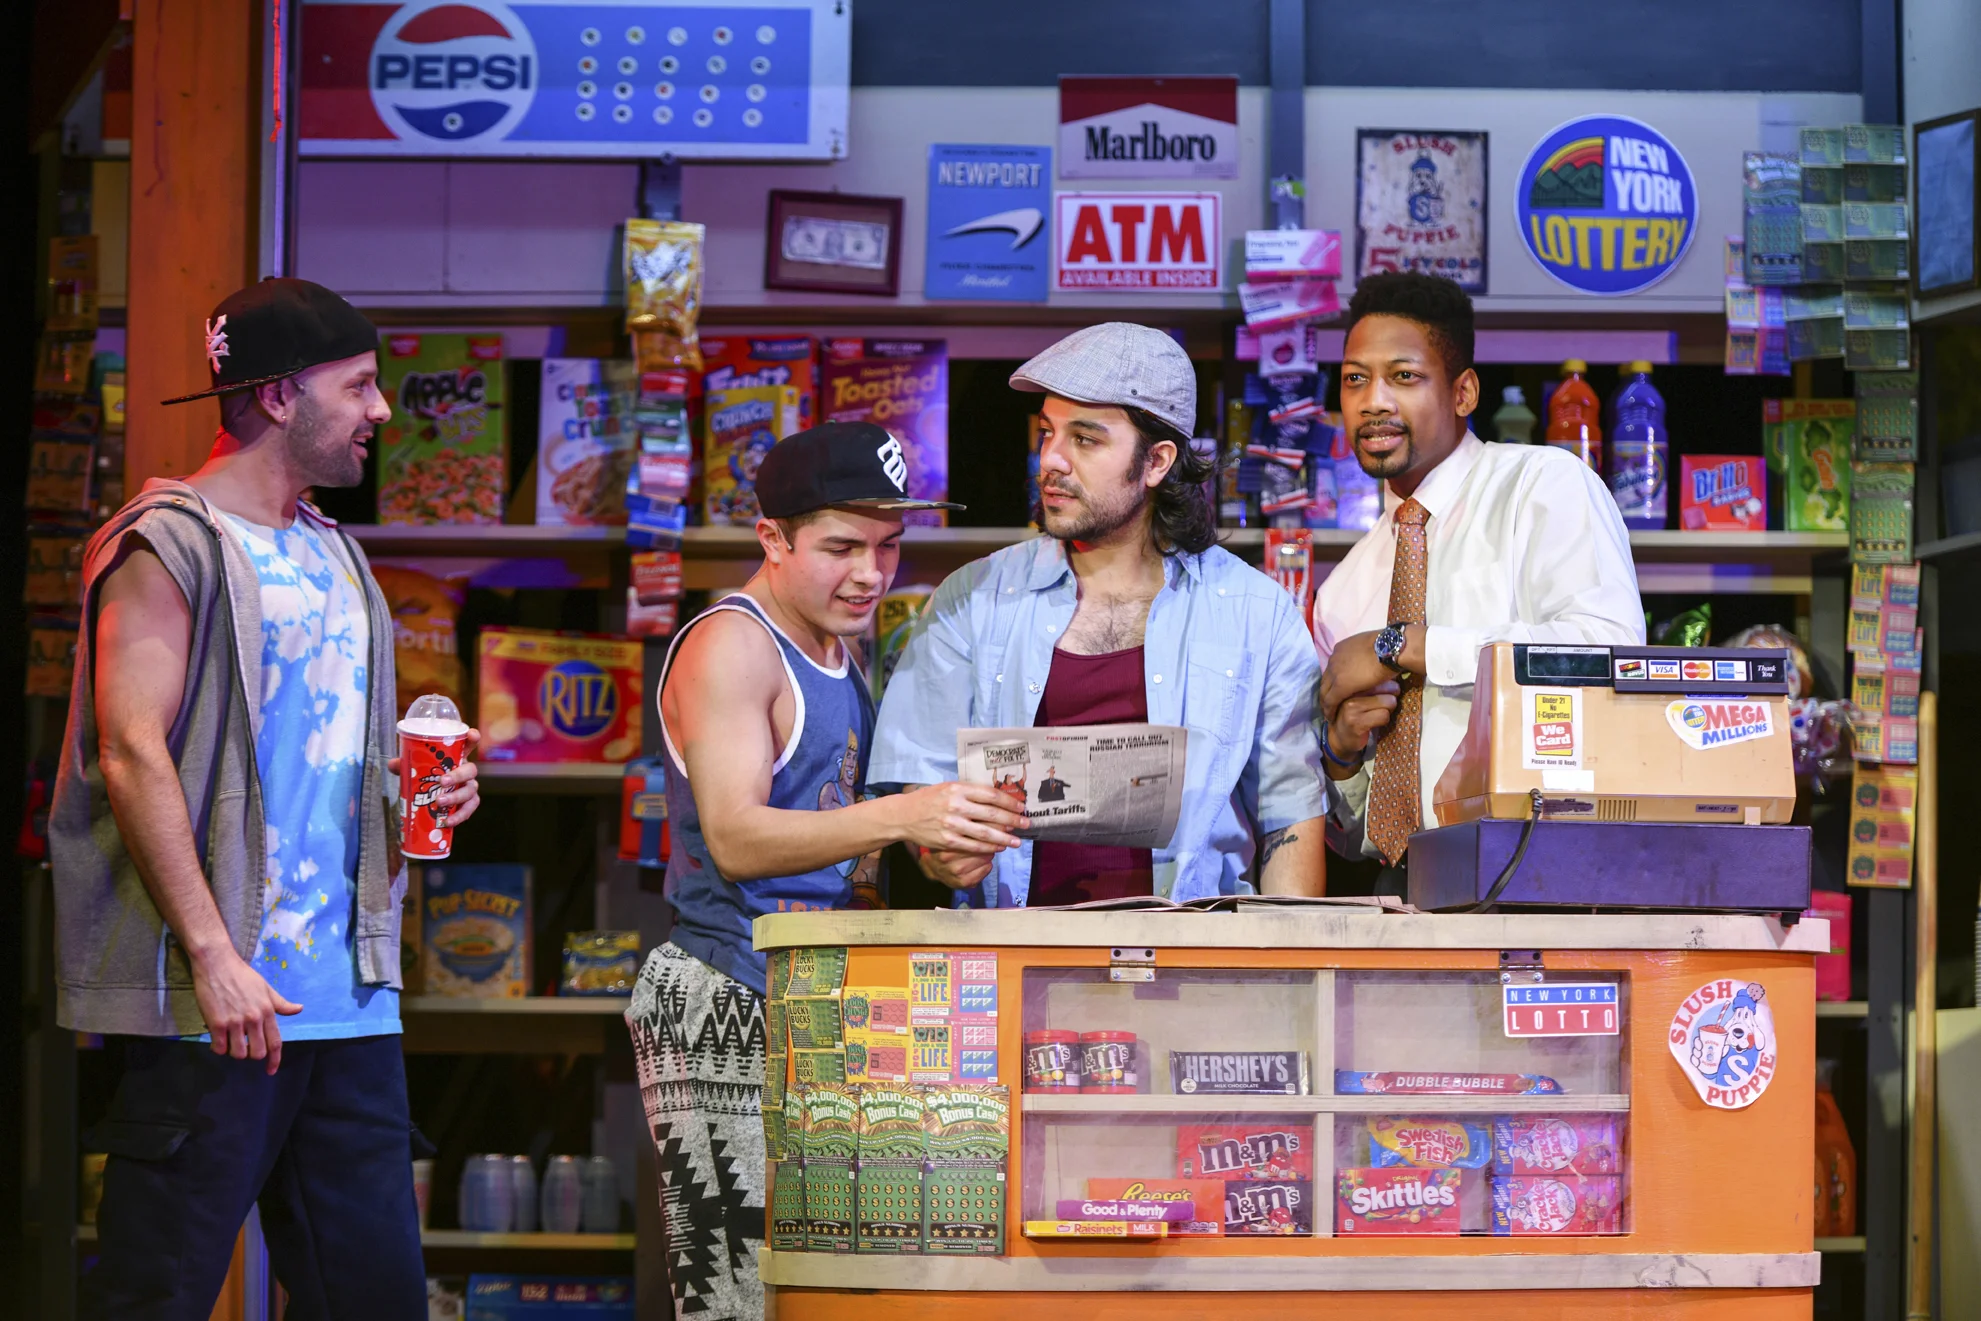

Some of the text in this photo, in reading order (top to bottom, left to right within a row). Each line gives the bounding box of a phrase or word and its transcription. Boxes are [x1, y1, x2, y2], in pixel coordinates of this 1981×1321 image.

[375, 54, 531, 91] PEPSI
[1084, 121, 1217, 162] Marlboro
[1392, 135, 1457, 156] SLUSH
[1610, 134, 1669, 172] NEW
[938, 161, 1043, 188] NEWPORT
[1612, 168, 1684, 214] YORK
[1066, 204, 1207, 264] ATM
[1384, 223, 1460, 244] PUPPIE
[1530, 213, 1688, 272] LOTTERY
[1061, 269, 1214, 286] AVAILABLE INSIDE
[832, 364, 939, 408] Toasted
[1655, 666, 1674, 674] VISA
[1757, 664, 1777, 672] Thank
[544, 670, 611, 728] RITZ
[1542, 696, 1558, 704] Under
[1550, 704, 1557, 712] No
[1702, 704, 1766, 731] MEGA
[1535, 734, 1571, 746] Card
[1540, 724, 1566, 736] We
[1702, 722, 1768, 746] MILLIONS
[1052, 804, 1086, 816] Tariffs
[795, 965, 815, 973] BUCKS
[796, 955, 815, 964] LUCKY
[911, 961, 948, 977] WIN
[920, 983, 948, 1002] LIFE
[1509, 988, 1611, 1002] NEW YORK
[789, 1006, 810, 1015] LUCKY
[790, 1015, 811, 1024] BUCKS
[1511, 1008, 1613, 1031] LOTTO
[1670, 980, 1733, 1045] SLUSH
[912, 1027, 949, 1042] WIN
[796, 1059, 813, 1068] LUCKY
[921, 1048, 949, 1067] LIFE
[796, 1068, 814, 1077] BUCKS
[1185, 1055, 1289, 1083] HERSHEY'S
[1395, 1076, 1506, 1089] DUBBLE BUBBLE
[925, 1092, 1006, 1113] $4,000,000
[811, 1105, 852, 1123] Bonus Cash
[865, 1104, 920, 1125] Bonus Cash
[938, 1105, 999, 1126] Bonus Cash
[1395, 1127, 1465, 1153] Swedish
[1535, 1121, 1555, 1171] Cracker
[1547, 1124, 1567, 1162] Jack
[1198, 1131, 1300, 1174] m&m's
[1413, 1142, 1455, 1166] Fish
[1121, 1182, 1192, 1201] Reese's
[1351, 1181, 1456, 1214] Skittles
[1081, 1202, 1118, 1216] Good
[1127, 1202, 1168, 1220] Plenty
[1533, 1177, 1553, 1233] Cracker
[1547, 1187, 1566, 1224] Jack
[1073, 1223, 1123, 1234] Raisinets
[1133, 1224, 1155, 1233] MILK
[1495, 1211, 1510, 1226] NEW
